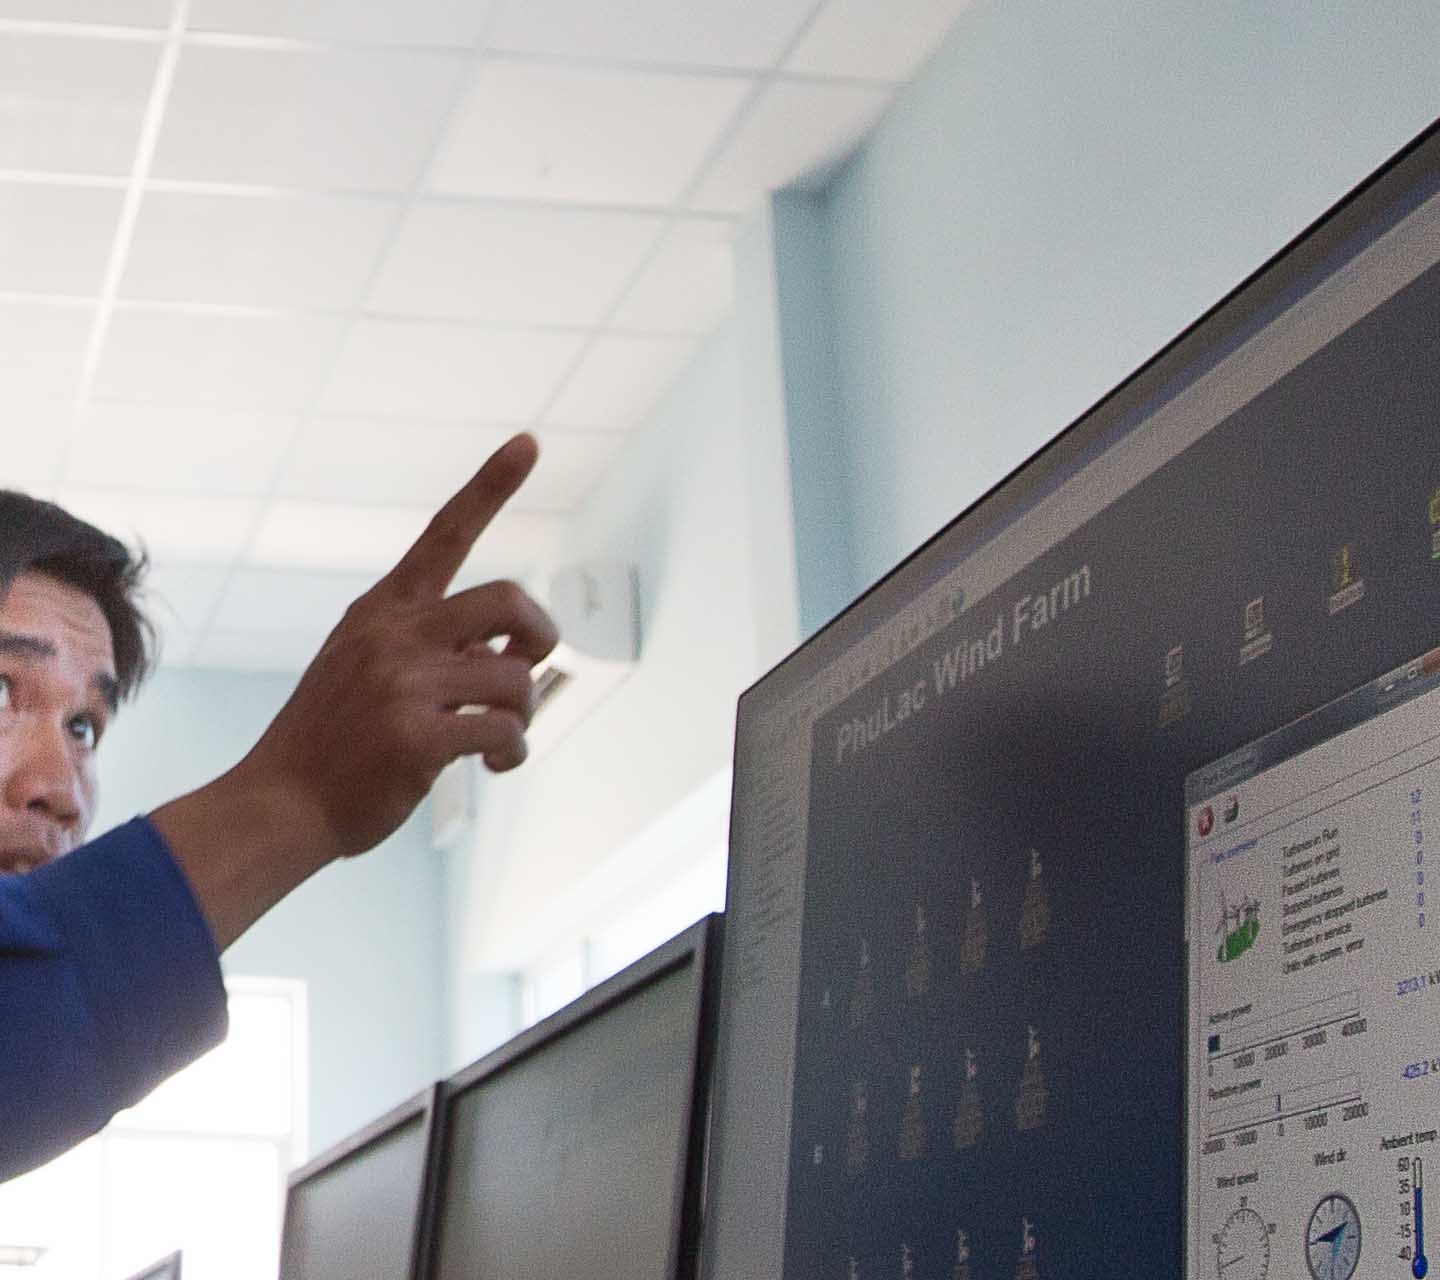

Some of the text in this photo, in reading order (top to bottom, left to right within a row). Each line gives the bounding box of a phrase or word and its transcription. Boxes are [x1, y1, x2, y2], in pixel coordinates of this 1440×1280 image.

[835, 564, 1093, 764] PhuLac Wind Farm
[1282, 867, 1340, 897] Paused turbines
[1281, 887, 1388, 938] Emergency stopped turbines
[1282, 935, 1315, 955] Turbines
[1323, 923, 1352, 939] service
[1380, 1134, 1414, 1153] Ambient
[1397, 1156, 1410, 1172] 60
[1399, 1201, 1411, 1217] 10
